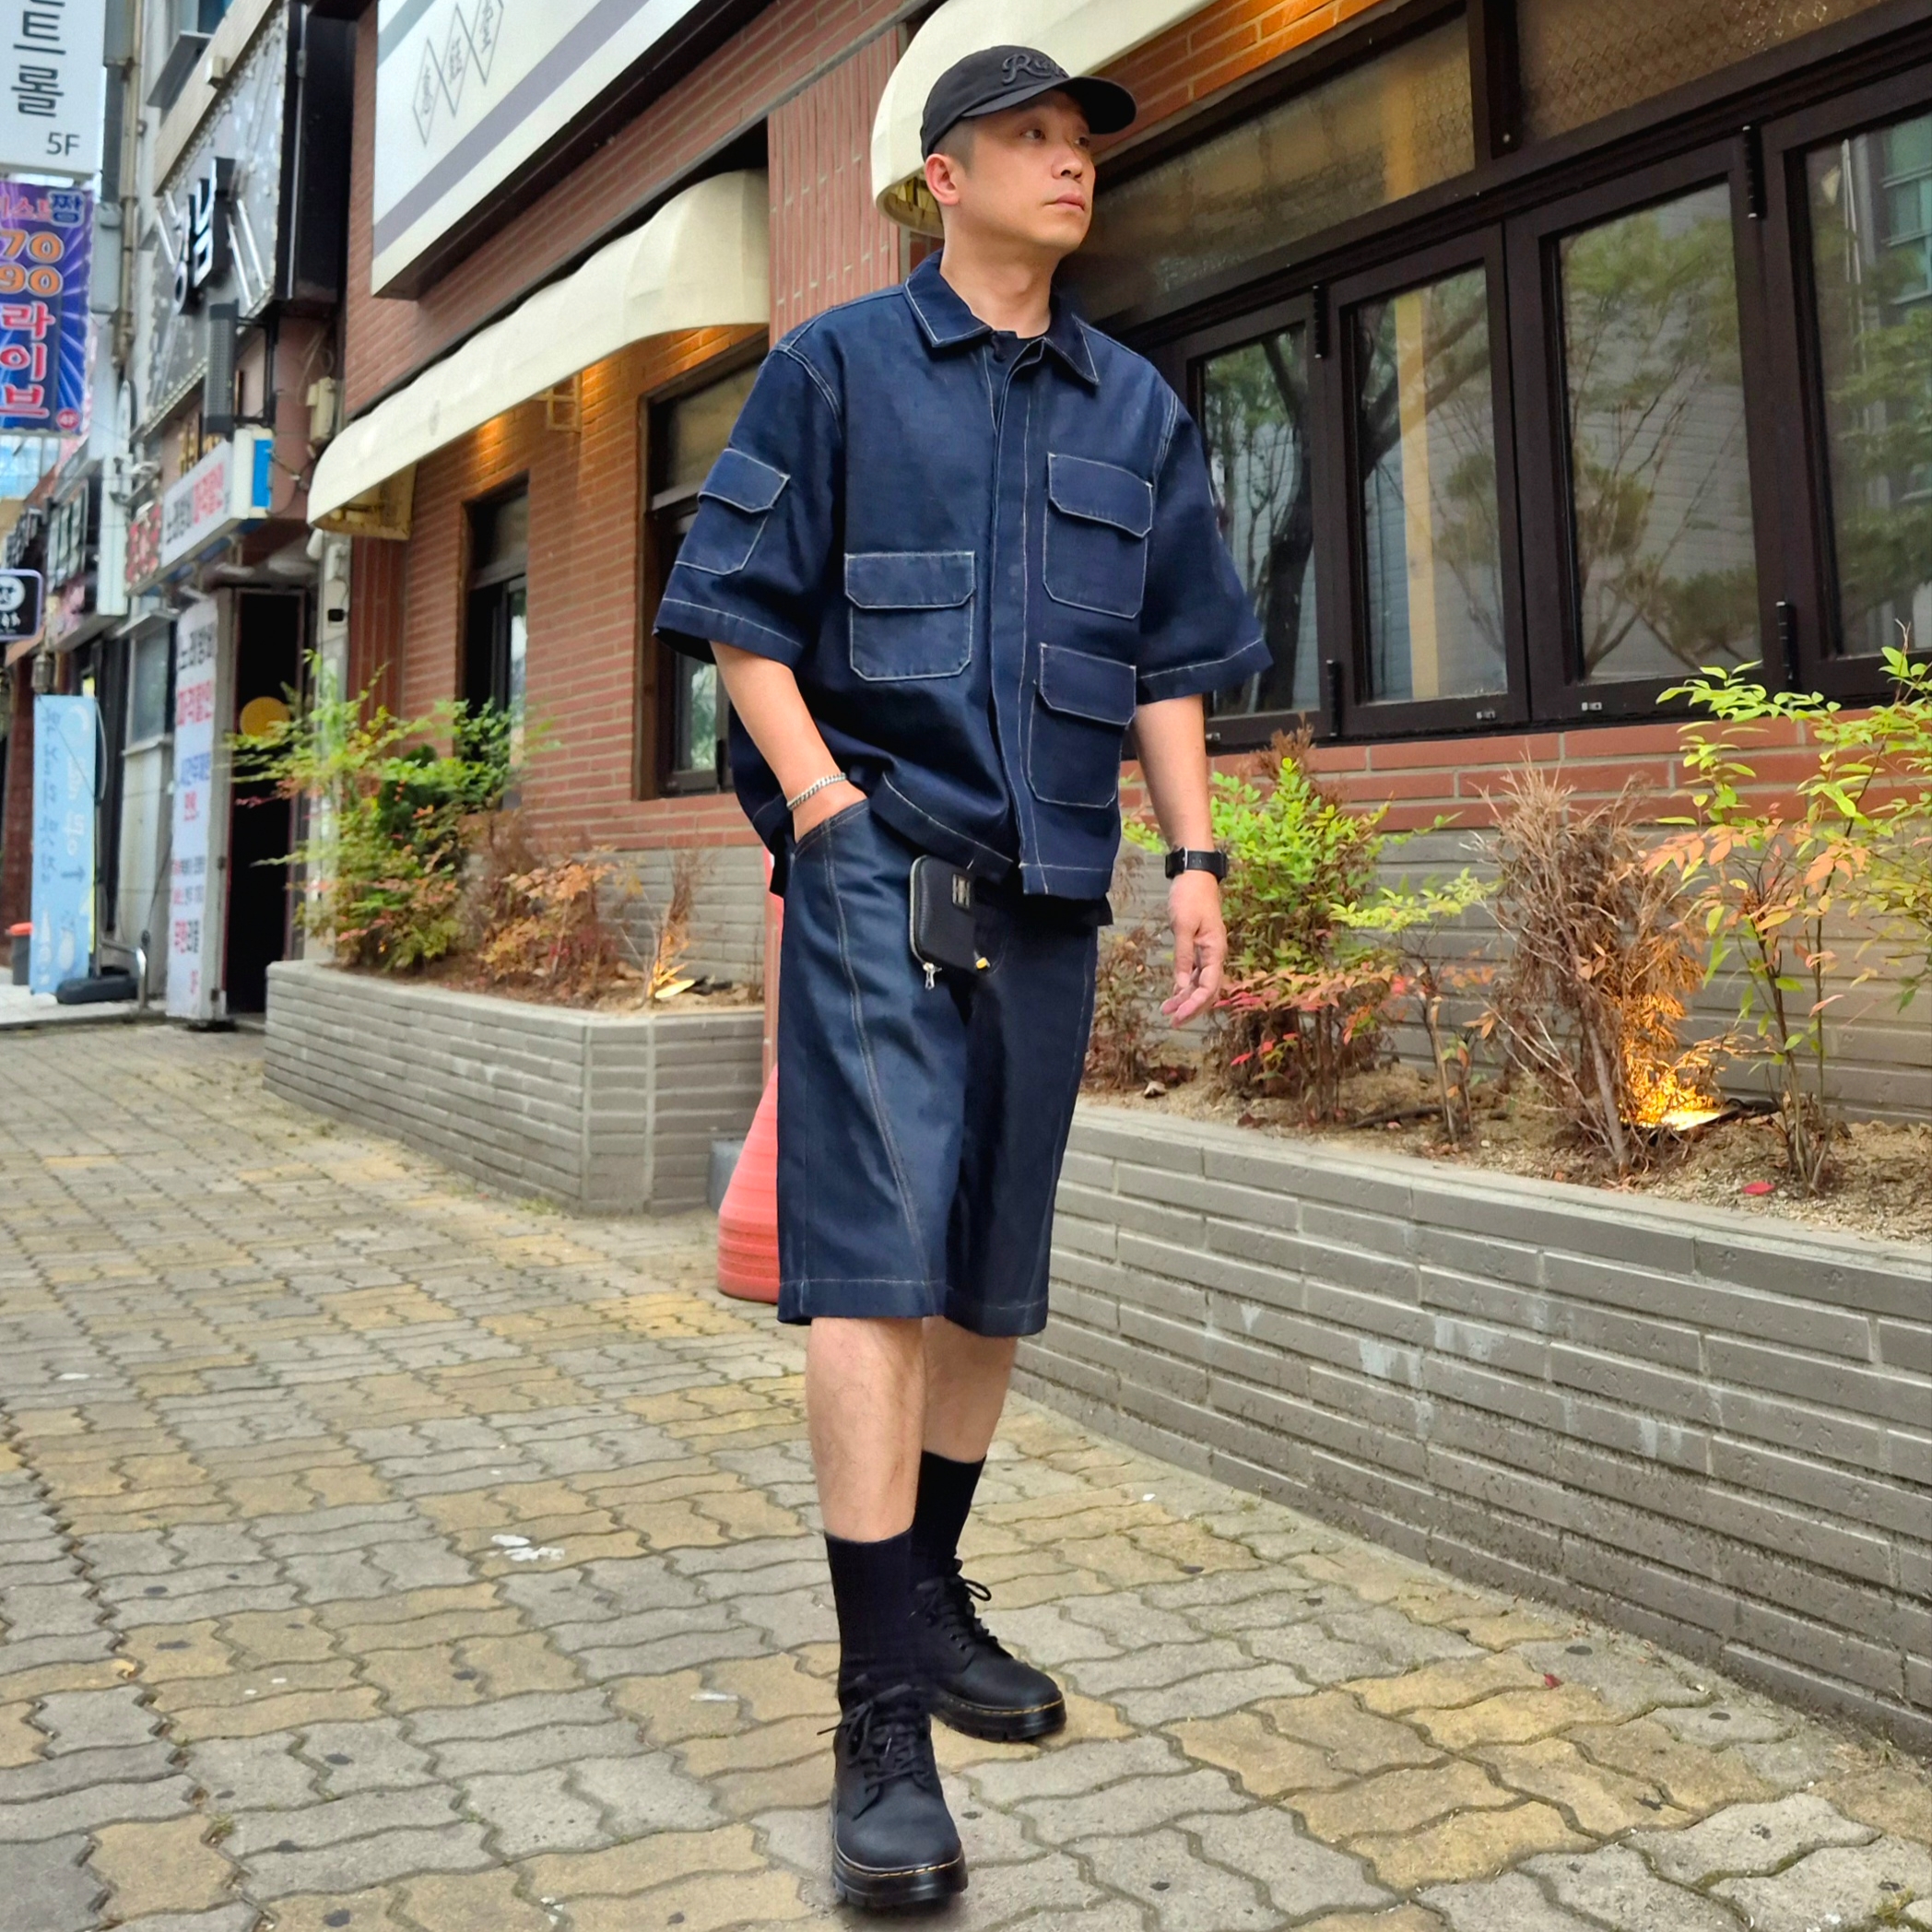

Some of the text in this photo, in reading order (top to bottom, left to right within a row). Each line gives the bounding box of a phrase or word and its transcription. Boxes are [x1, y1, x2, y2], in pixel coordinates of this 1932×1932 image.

[11, 0, 65, 118] 트롤
[46, 131, 80, 156] 5F
[0, 301, 55, 418] 라이브
